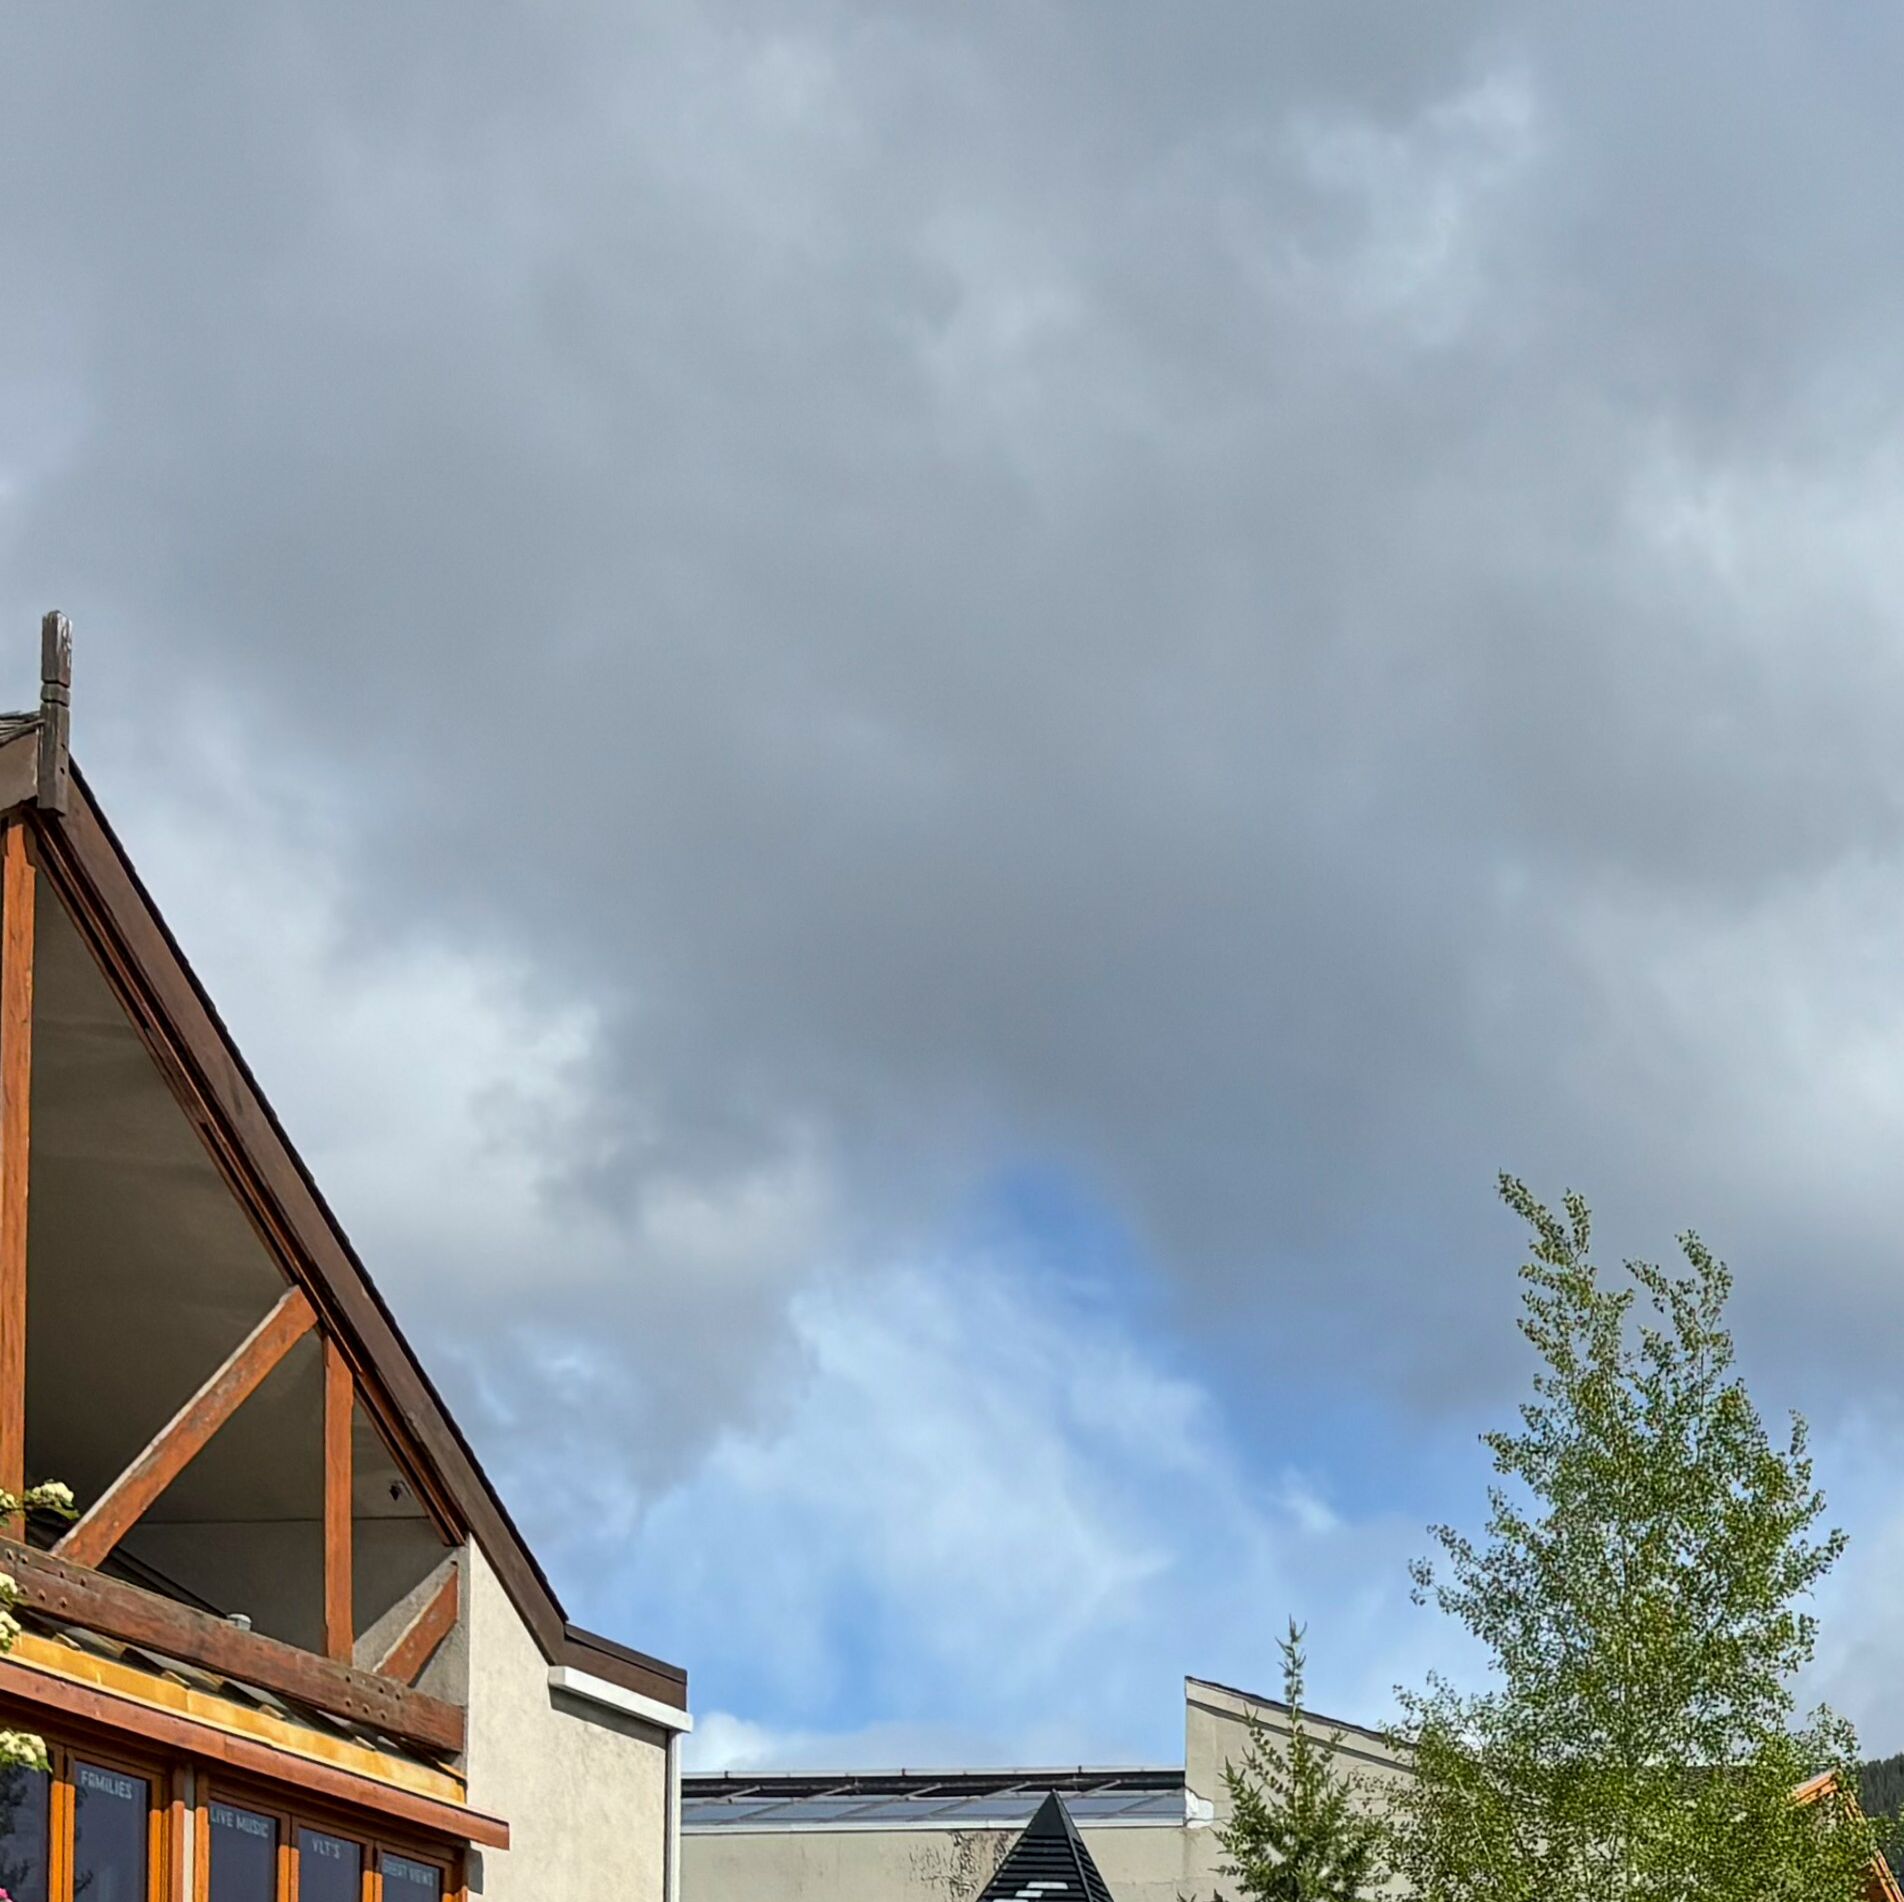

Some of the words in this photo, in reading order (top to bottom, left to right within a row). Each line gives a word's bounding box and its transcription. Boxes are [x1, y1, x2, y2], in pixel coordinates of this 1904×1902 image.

[80, 1769, 133, 1799] FAMILIES
[210, 1805, 234, 1829] LIVE
[236, 1814, 269, 1839] MUSIC
